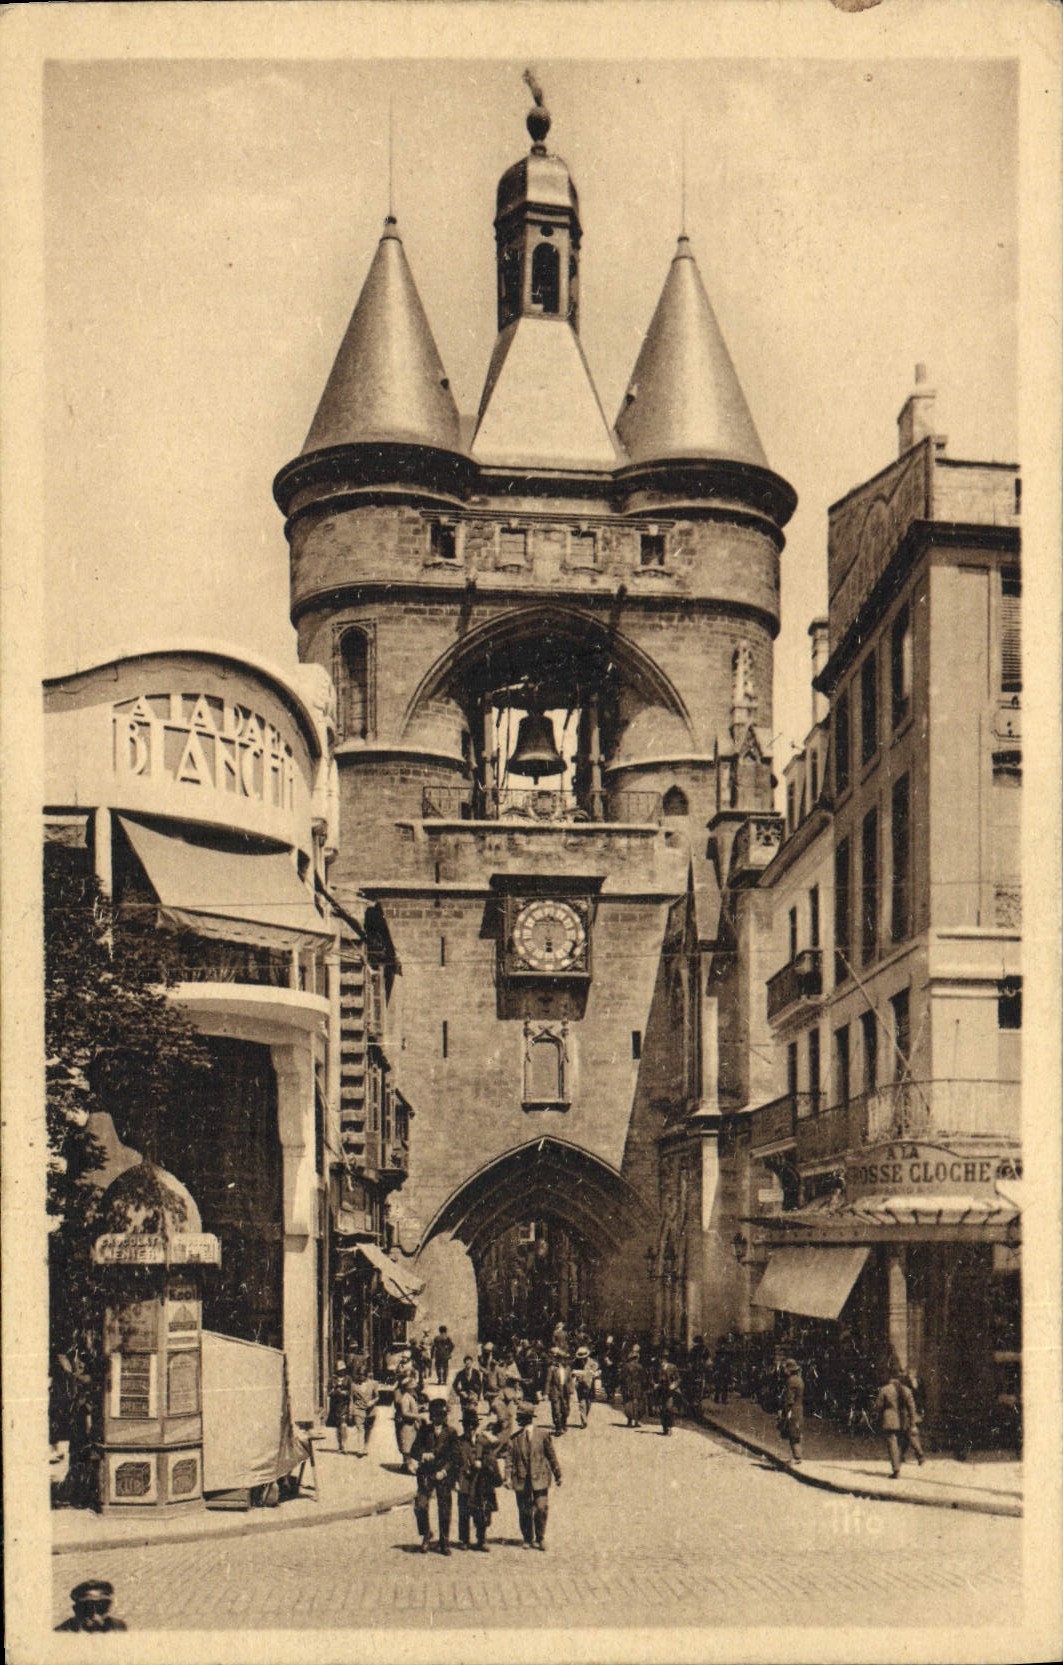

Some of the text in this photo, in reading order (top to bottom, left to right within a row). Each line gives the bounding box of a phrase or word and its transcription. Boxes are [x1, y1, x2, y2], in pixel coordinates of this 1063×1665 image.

[886, 1146, 919, 1160] A LA
[909, 1161, 991, 1184] CLOCHE
